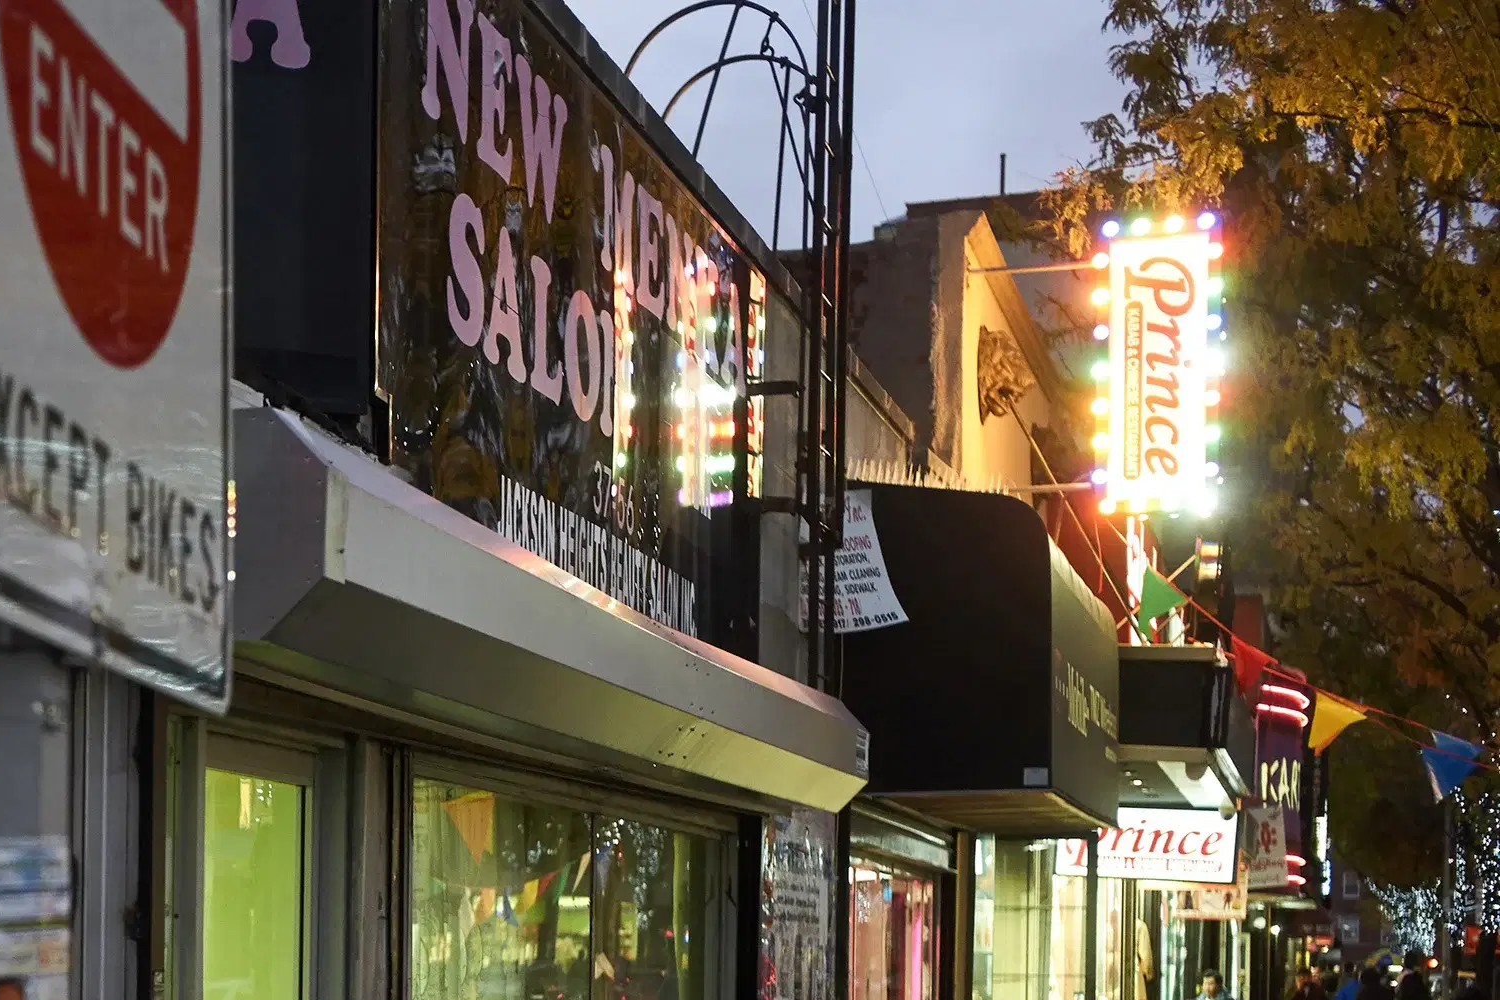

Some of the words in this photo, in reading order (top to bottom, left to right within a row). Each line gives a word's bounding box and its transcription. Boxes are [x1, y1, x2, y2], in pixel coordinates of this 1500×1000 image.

[28, 23, 170, 274] ENTER
[421, 0, 567, 224] NEW
[1124, 256, 1196, 476] Prince
[126, 461, 219, 612] BIKES
[498, 474, 556, 567] JACKSON
[559, 506, 608, 594] HEIGHTS
[610, 534, 650, 615] BEAUTY
[649, 557, 680, 632] SALON
[848, 566, 881, 581] CLEANING
